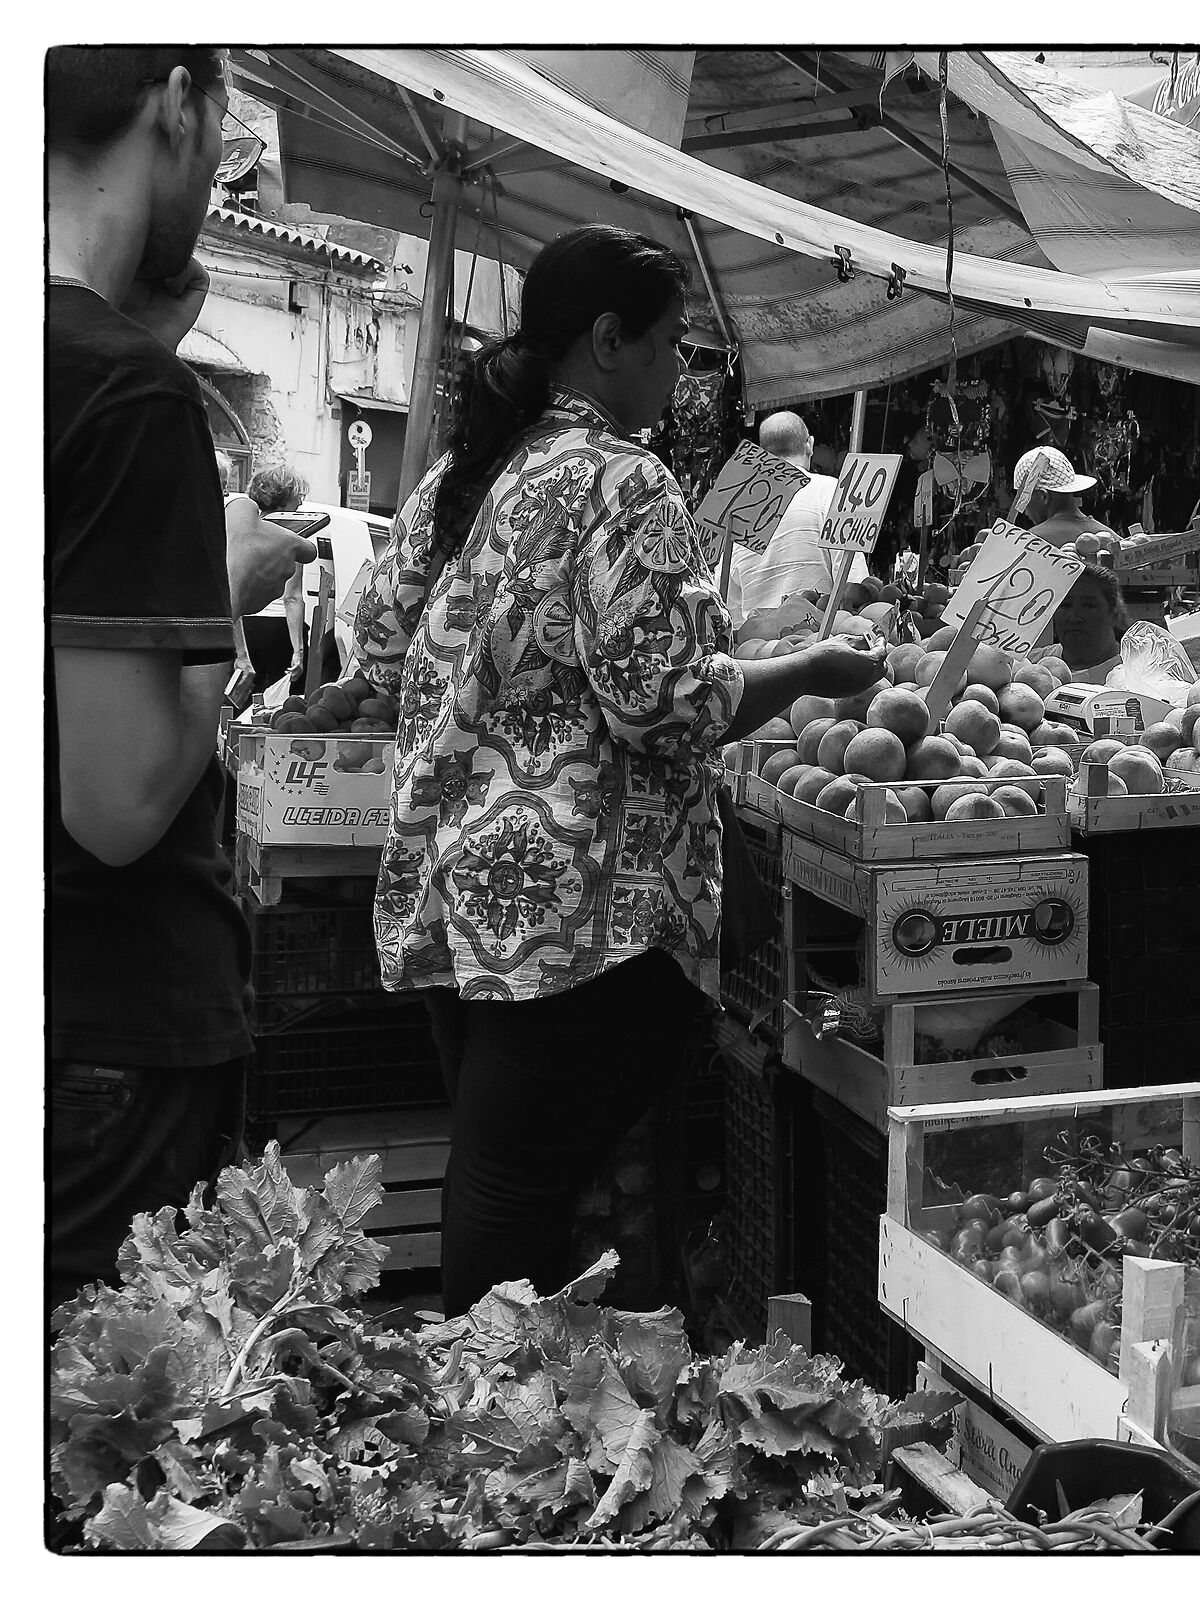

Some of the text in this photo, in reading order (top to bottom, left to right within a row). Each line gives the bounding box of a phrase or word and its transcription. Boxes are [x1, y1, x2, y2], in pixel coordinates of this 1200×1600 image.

[991, 521, 1082, 576] OFFERTA
[282, 806, 362, 826] LLEIDA
[941, 913, 1031, 943] MIELE
